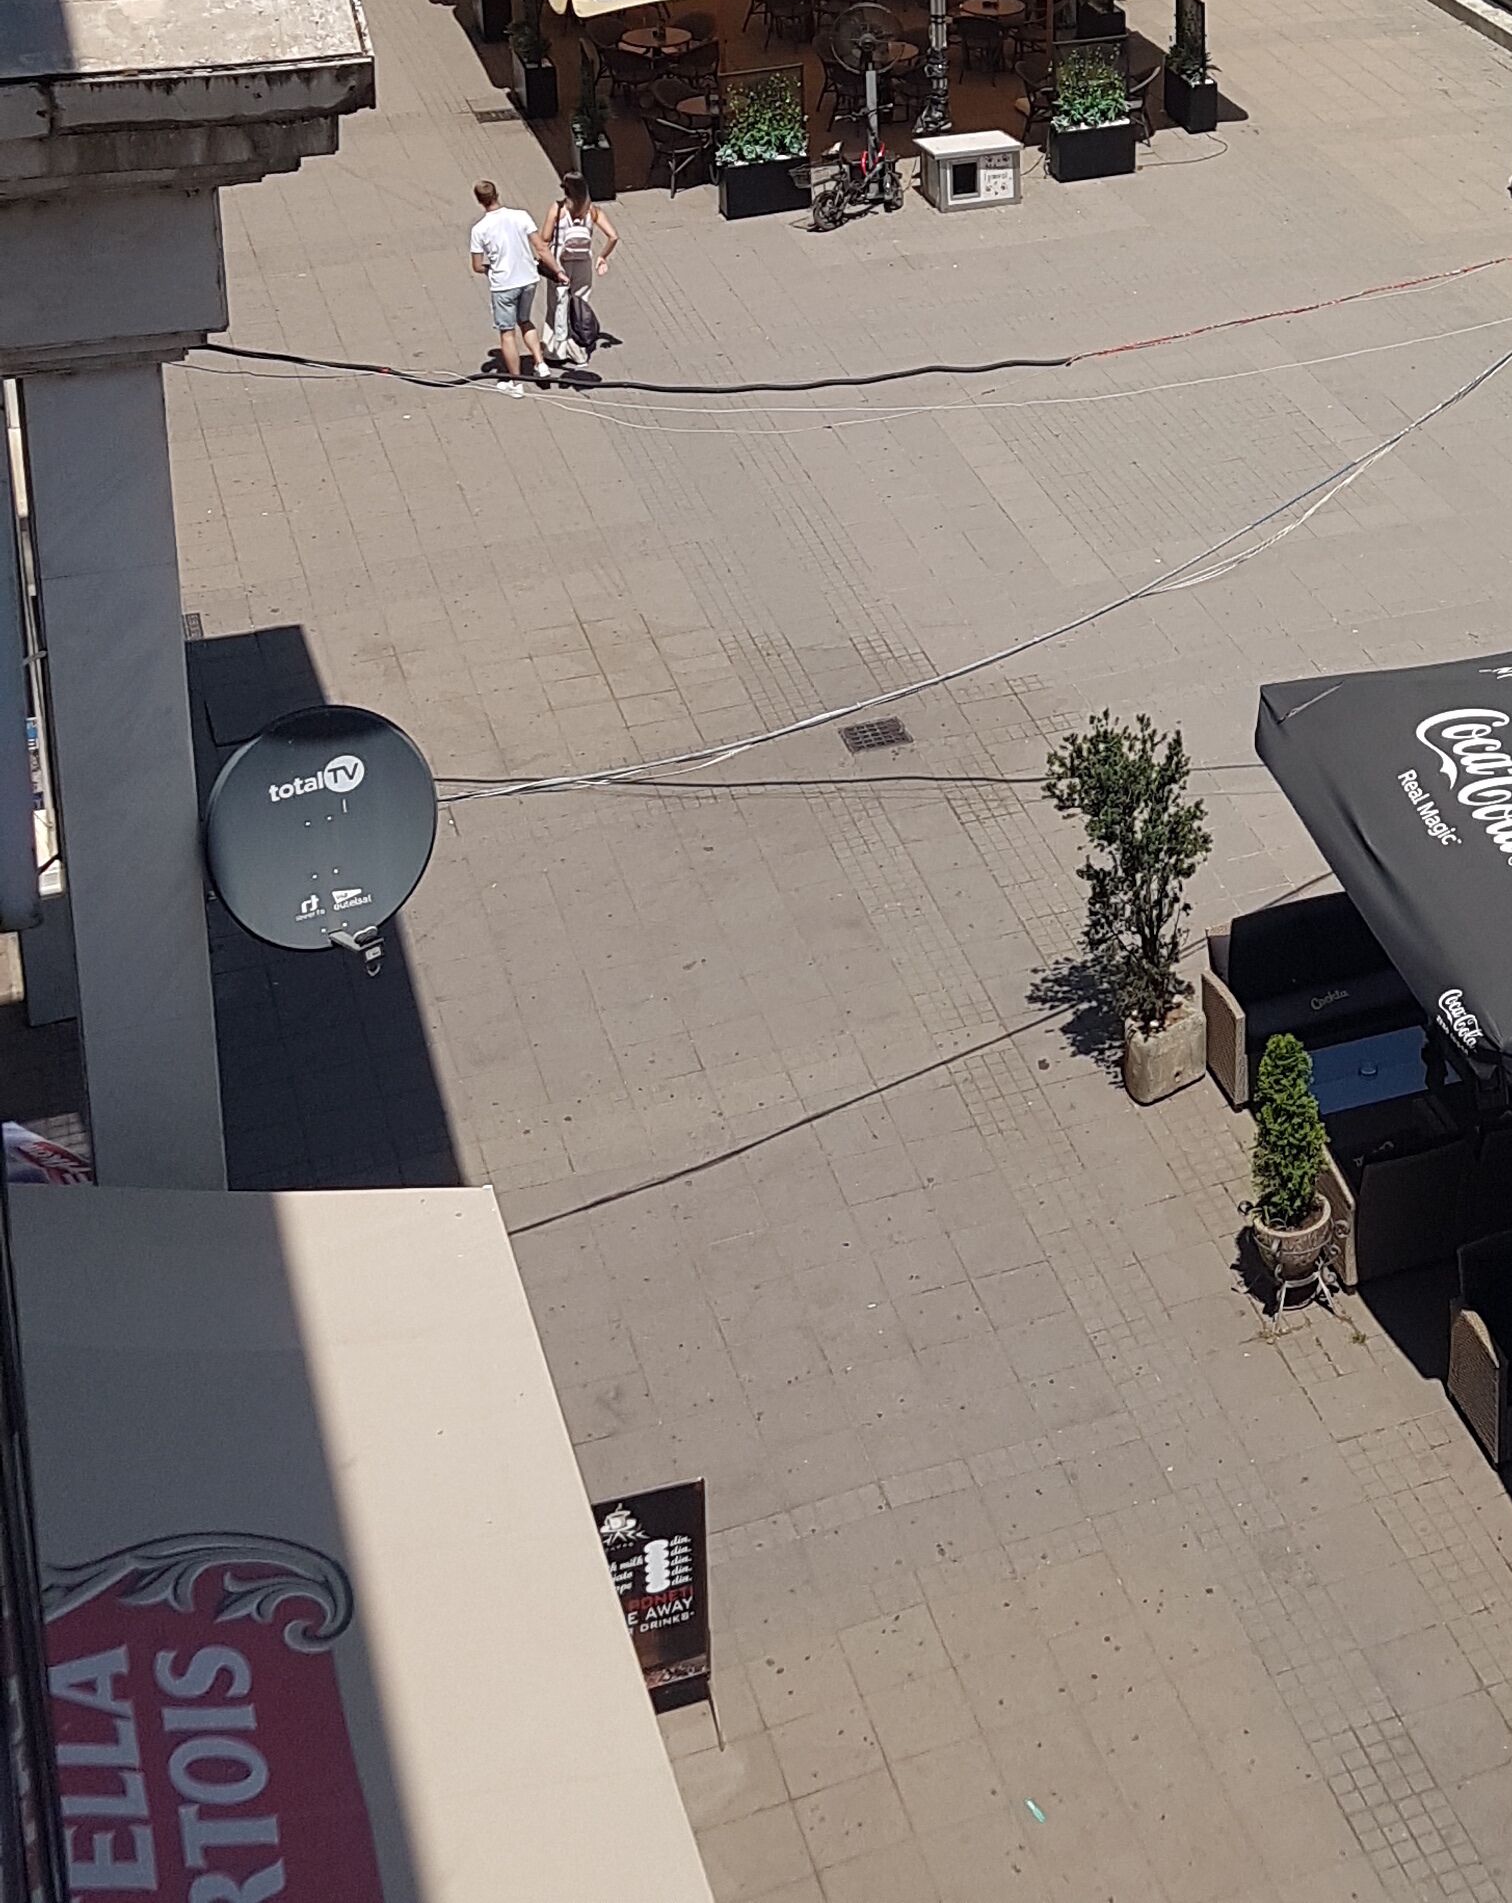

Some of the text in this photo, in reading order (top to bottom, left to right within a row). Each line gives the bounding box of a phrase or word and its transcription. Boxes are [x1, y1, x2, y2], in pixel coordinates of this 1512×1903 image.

[1397, 770, 1463, 846] Real Magic
[645, 1596, 694, 1620] AWAY
[47, 1644, 158, 1892] ELLA
